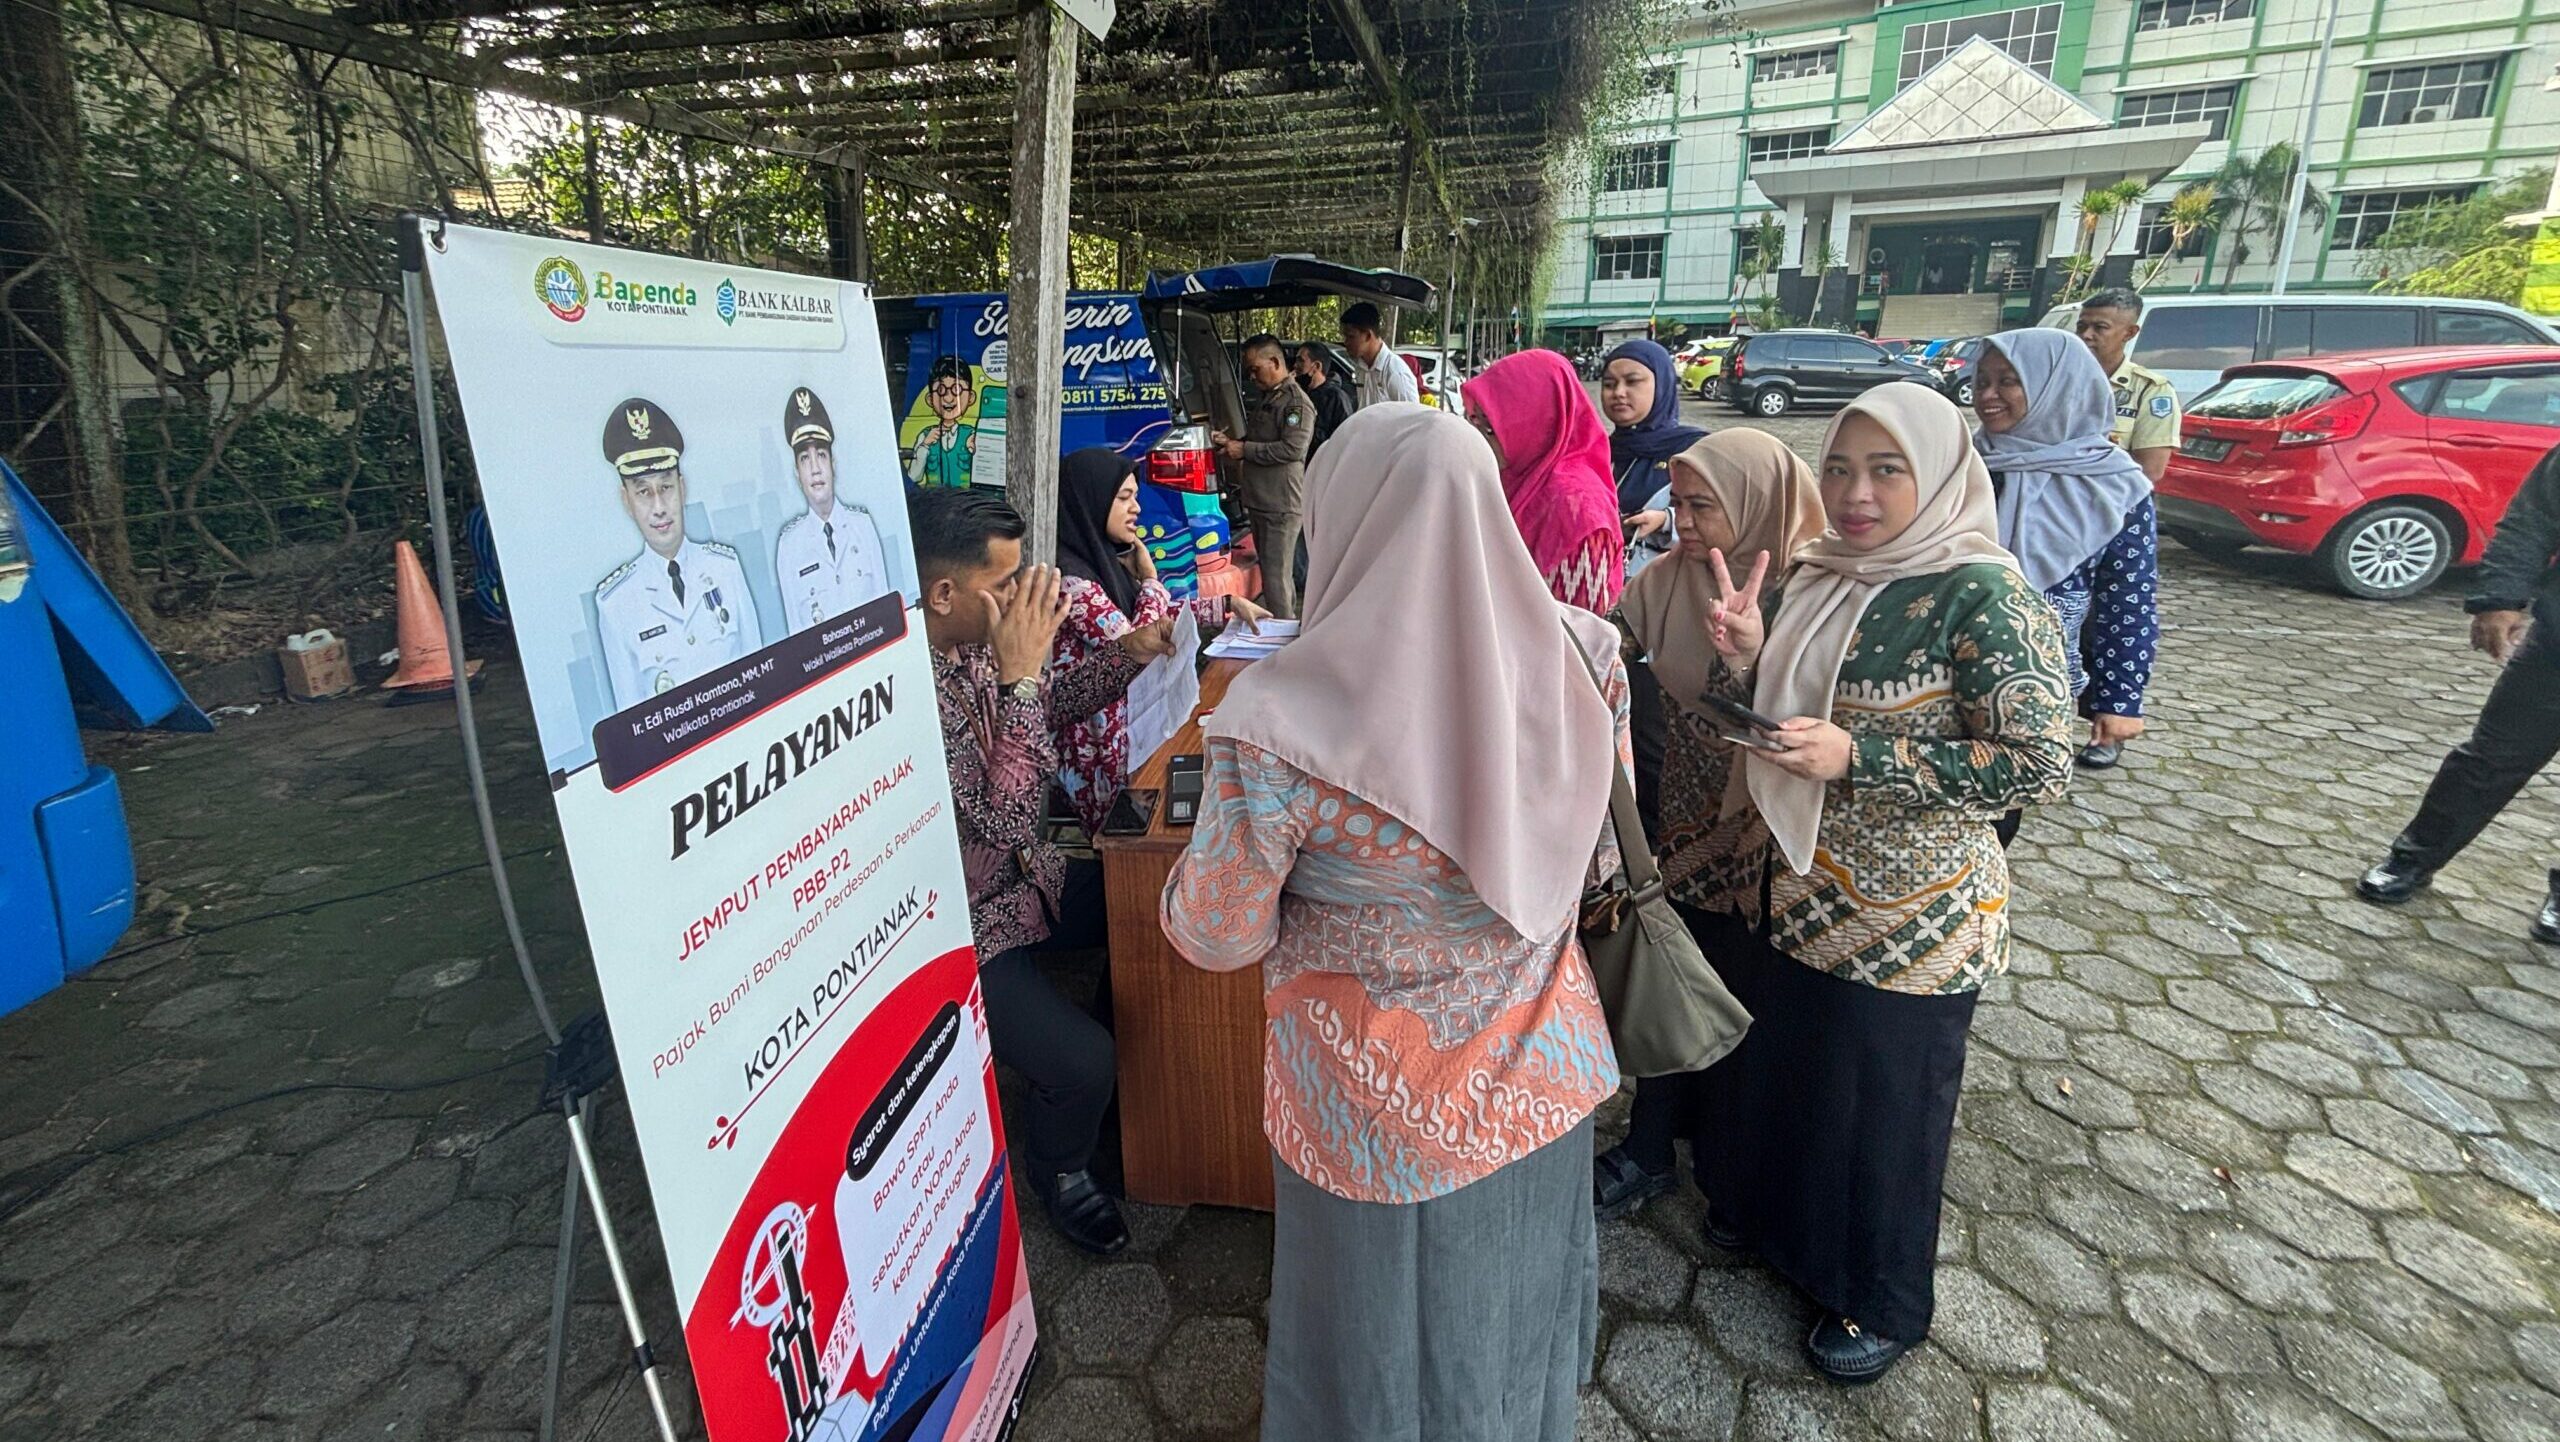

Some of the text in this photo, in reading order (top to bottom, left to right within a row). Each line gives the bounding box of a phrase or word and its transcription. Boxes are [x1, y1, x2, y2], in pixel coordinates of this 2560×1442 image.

[594, 271, 697, 312] Bapenda
[607, 301, 689, 317] KOTA PONTIANAK
[738, 289, 833, 315] BANK KALBAR
[1061, 387, 1167, 405] 0811 5754 275
[802, 625, 885, 673] Wakil Walikota Pontianak
[822, 624, 854, 645] Bahasan,
[631, 658, 775, 736] Ir. Edi Rusdi Kamtono, MM, MT
[663, 690, 756, 744] Walikota Pontianak
[670, 674, 895, 861] PELAYANAN
[679, 755, 914, 961] JEMPUT PEMBAYARAN PAJAK
[792, 848, 852, 912] PBB-P2
[652, 801, 942, 1079] Pajak Bumi Bangunan Perdesaan & Perkotaan
[744, 885, 919, 1092] KOTA PONTIANAK
[852, 1014, 957, 1166] Syarat dan kelengkapan
[872, 1075, 959, 1213] Bawa SPPT Anda
[911, 1146, 935, 1190] atau
[872, 1110, 977, 1293] sebutkan NOPD Anda
[892, 1153, 971, 1295] kepada Petugas
[872, 1174, 1004, 1432] Pajakku Untukmu Kota Pontianakku
[988, 1320, 1024, 1400] Pontianak
